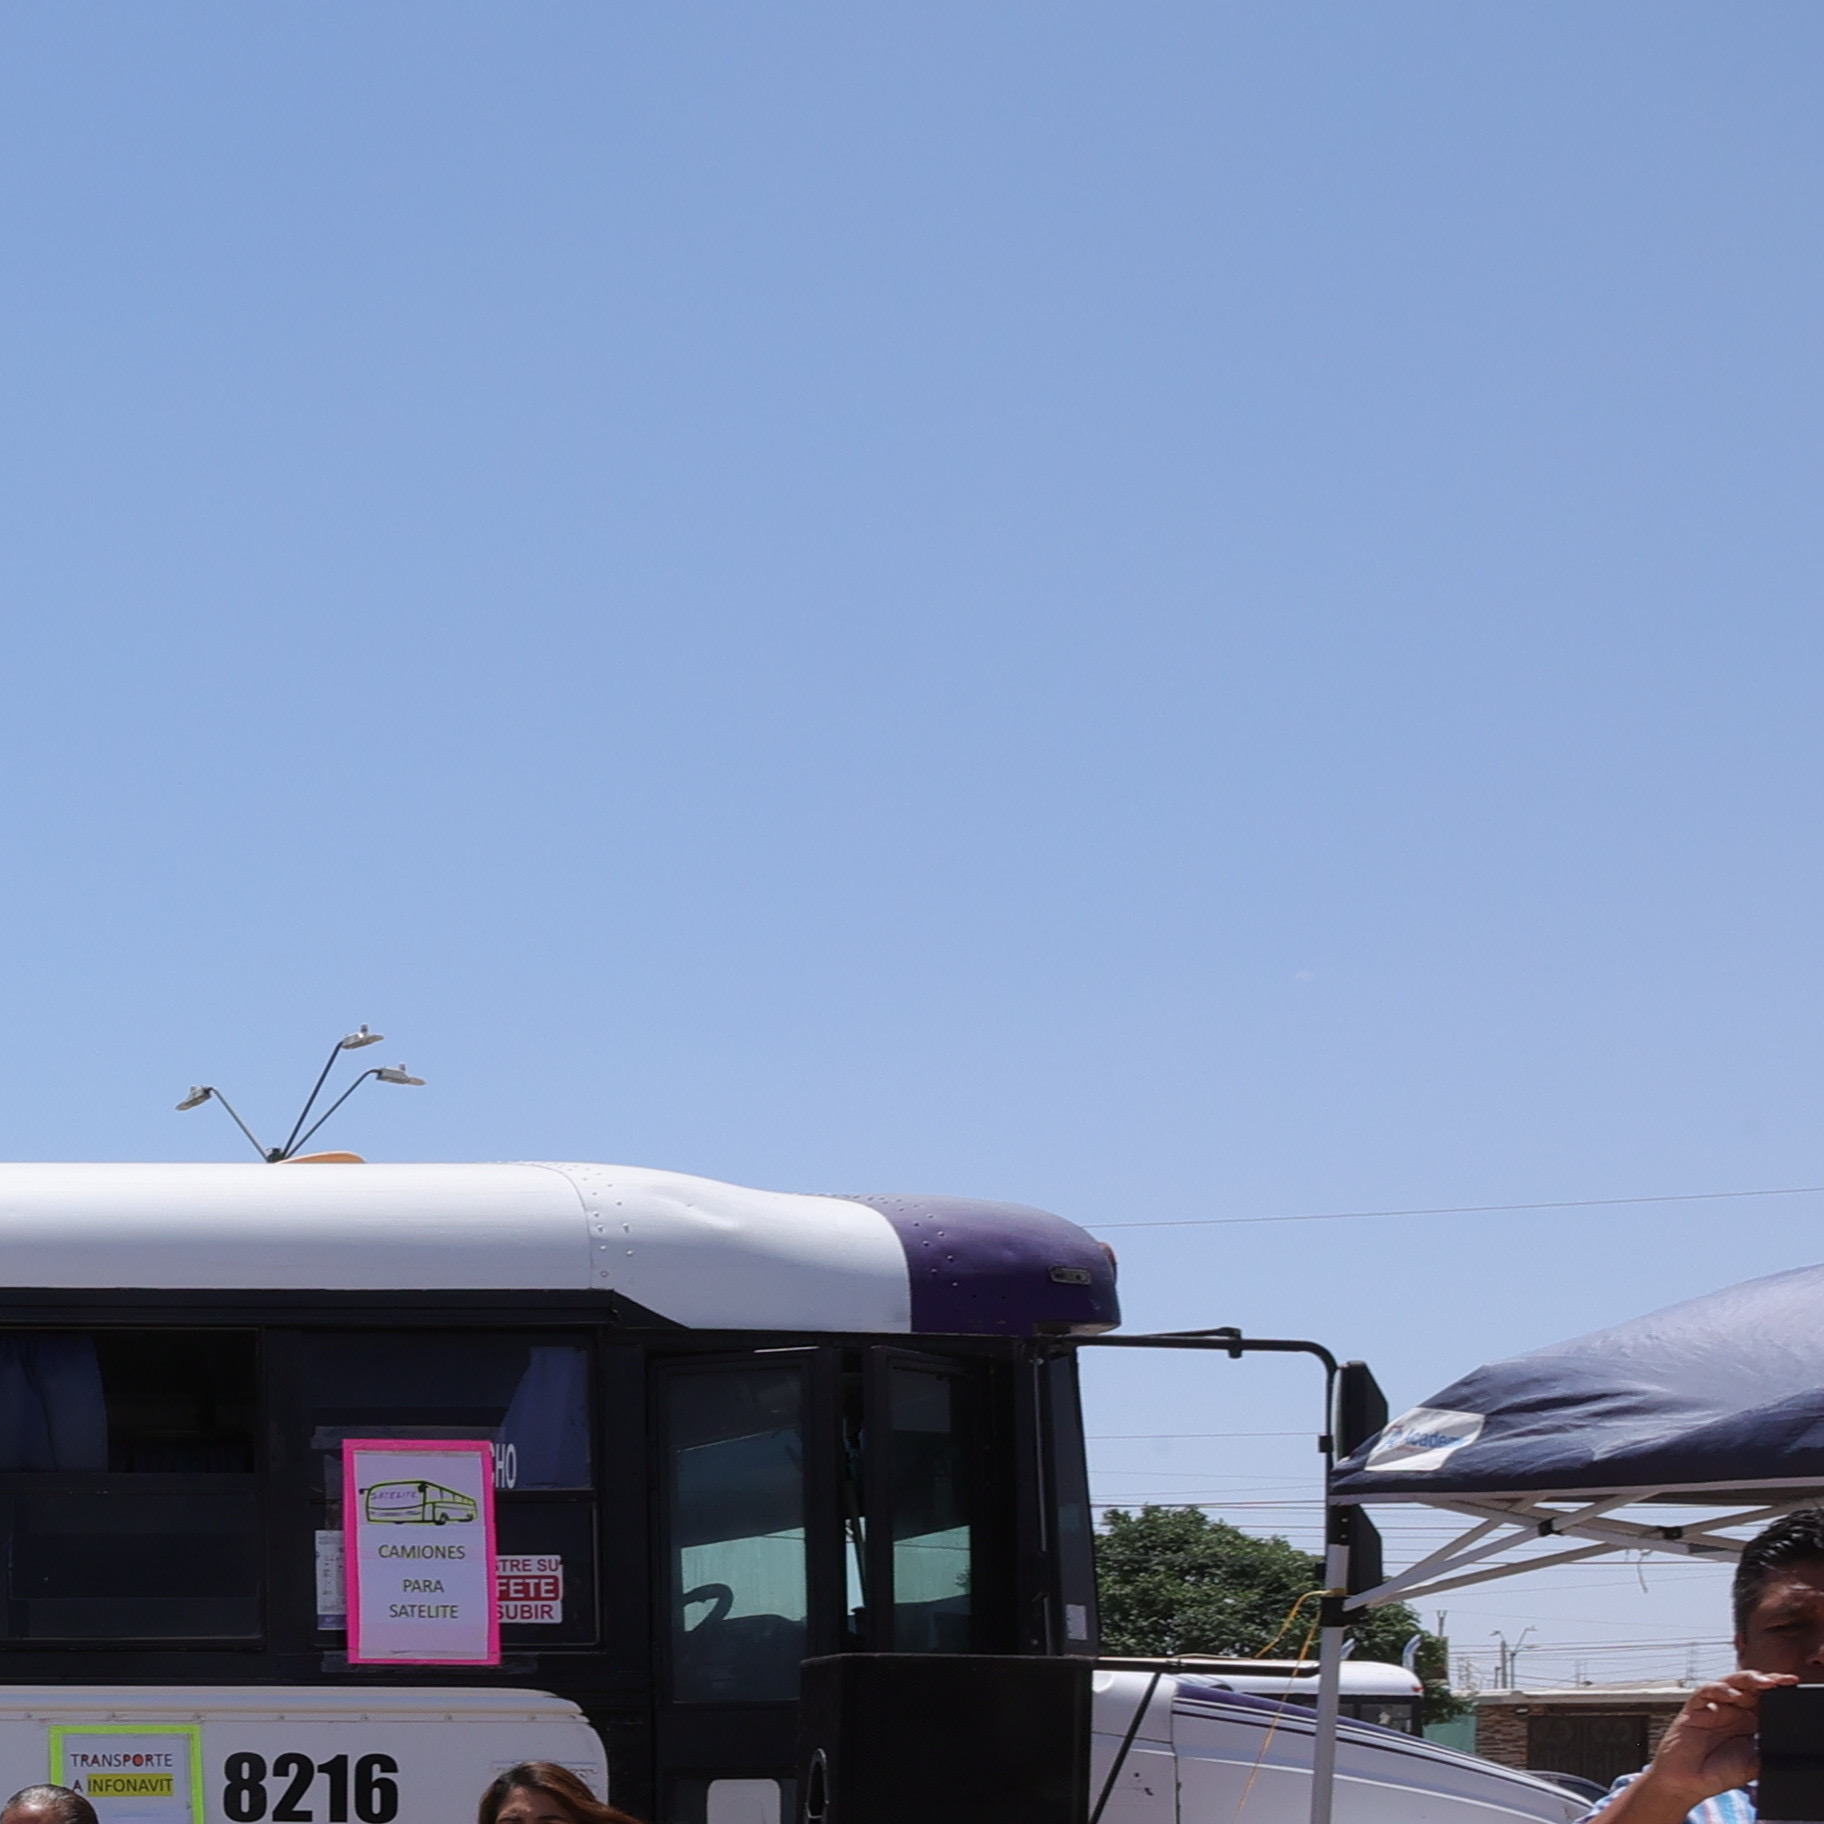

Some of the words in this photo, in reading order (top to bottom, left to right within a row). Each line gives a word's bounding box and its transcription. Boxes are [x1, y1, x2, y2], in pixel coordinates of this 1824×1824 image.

[378, 1544, 466, 1560] CAMIONES
[537, 1558, 560, 1572] SU
[403, 1579, 445, 1593] PARA
[389, 1604, 459, 1619] SATELITE
[70, 1753, 173, 1768] TRANSPORTE
[72, 1779, 83, 1792] A
[87, 1778, 173, 1793] INFONAVIT
[223, 1751, 399, 1824] 8216
